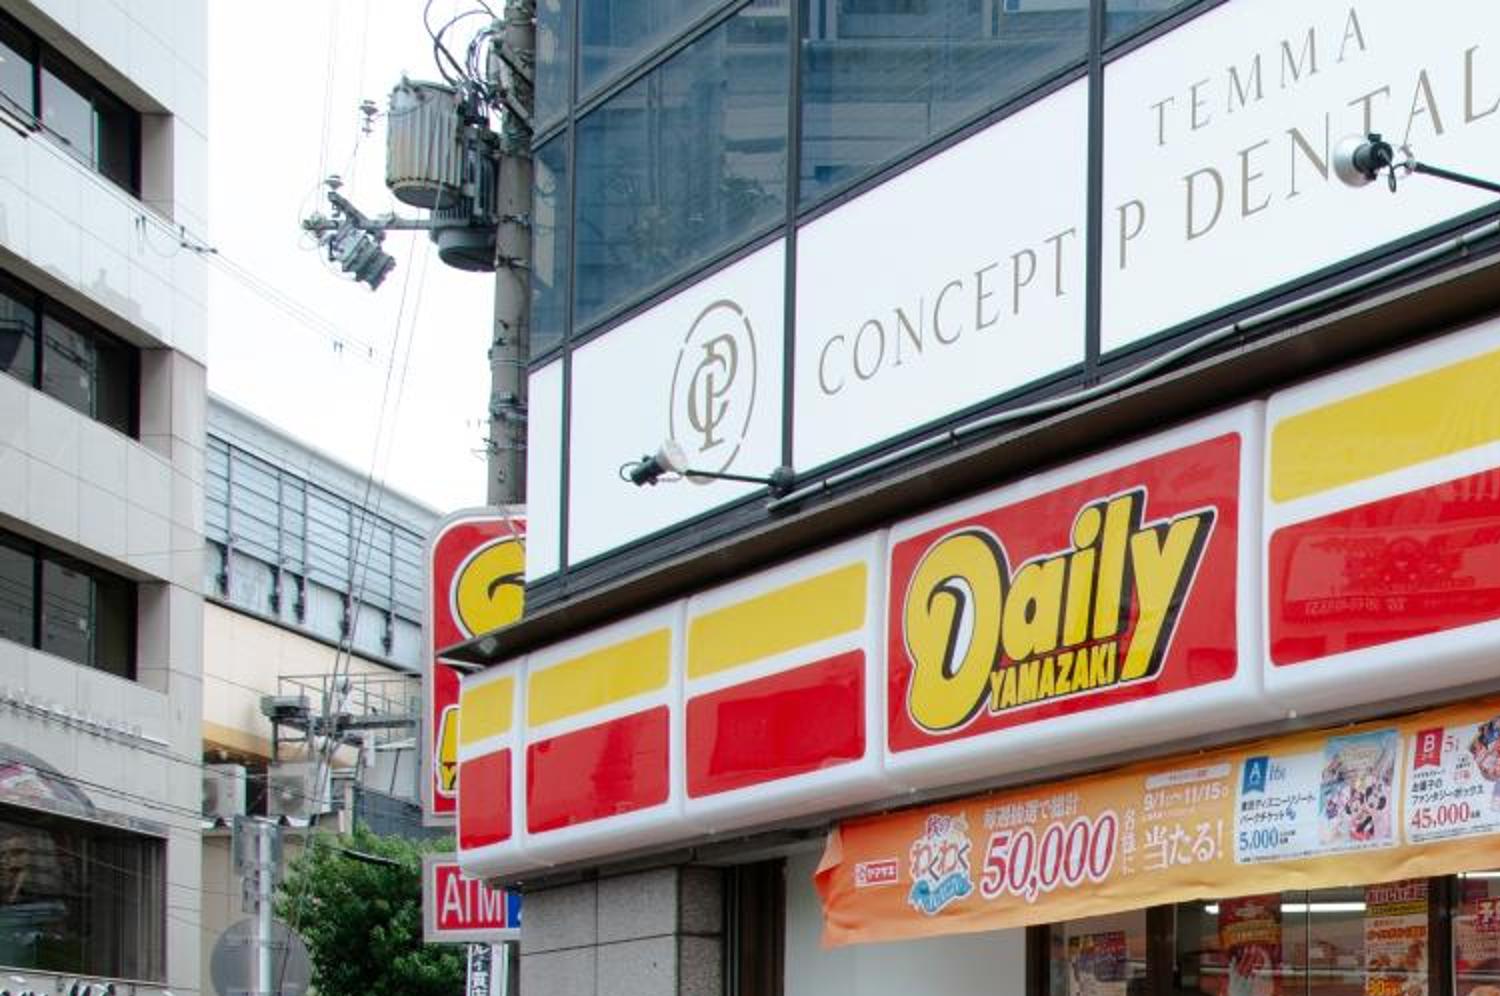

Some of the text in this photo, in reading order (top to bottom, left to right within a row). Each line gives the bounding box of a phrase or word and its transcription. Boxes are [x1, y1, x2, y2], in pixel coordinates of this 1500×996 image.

[1151, 6, 1367, 147] TEMMA
[817, 228, 1077, 396] CONCEPT
[1118, 199, 1147, 270] P
[904, 486, 1217, 734] Daily
[989, 640, 1119, 714] YAMAZAKI
[1424, 734, 1436, 753] B
[981, 812, 1117, 899] 50,000
[1411, 801, 1471, 830] 45,000
[441, 873, 502, 924] ATM
